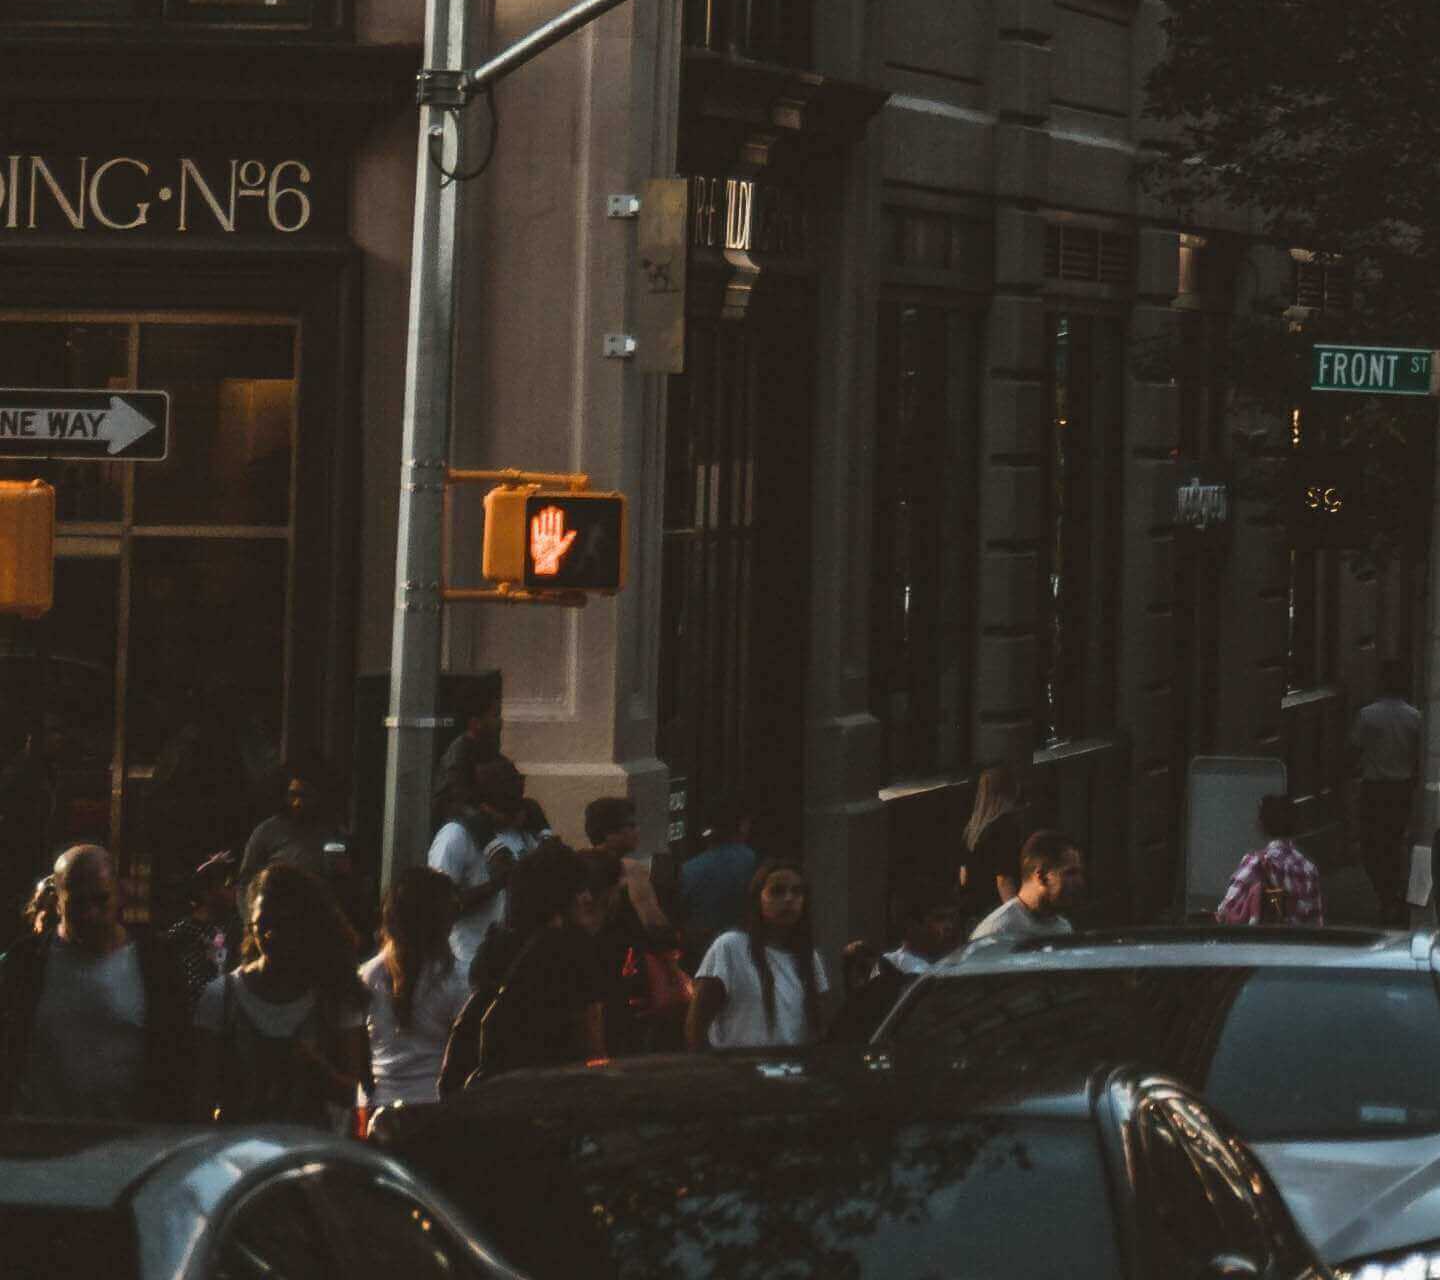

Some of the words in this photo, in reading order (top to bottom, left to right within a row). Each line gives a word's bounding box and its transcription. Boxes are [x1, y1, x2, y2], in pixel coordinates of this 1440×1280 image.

[0, 155, 151, 230] ING
[1318, 351, 1399, 386] FRONT
[1409, 355, 1430, 375] ST
[47, 410, 107, 438] WAY
